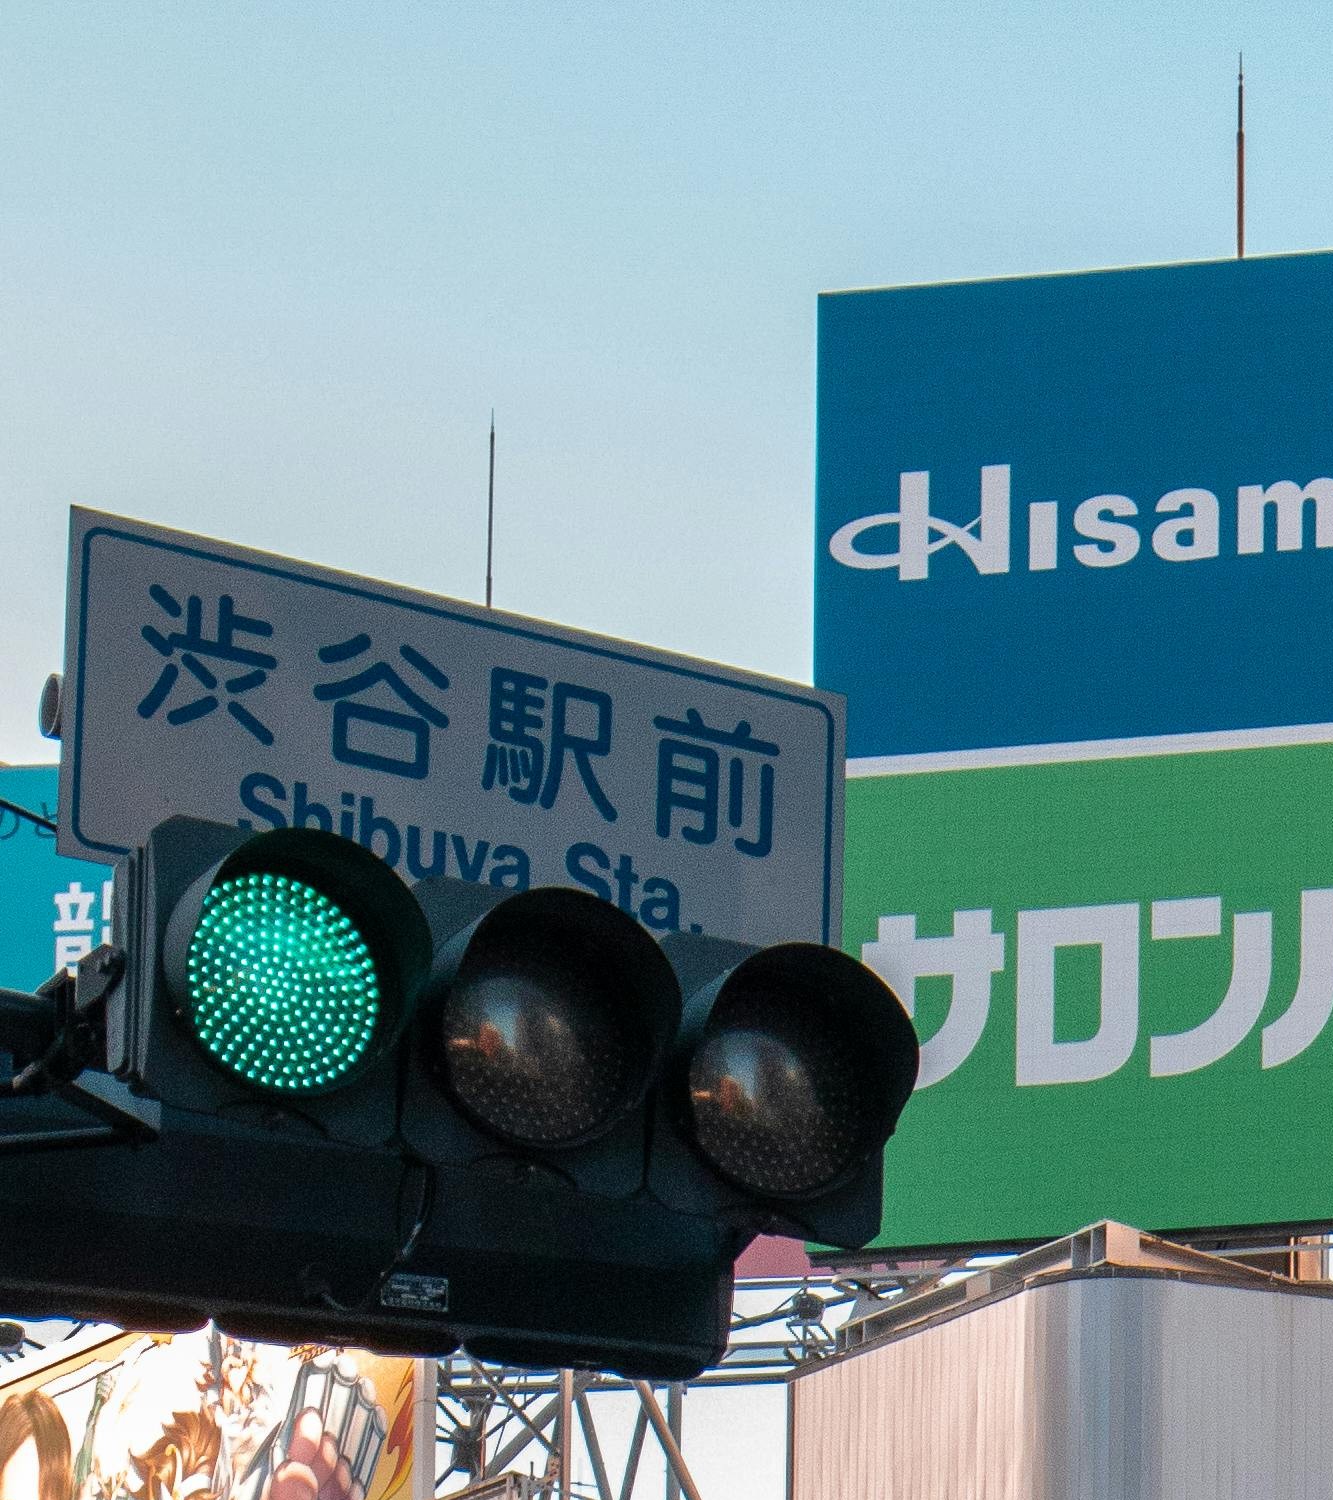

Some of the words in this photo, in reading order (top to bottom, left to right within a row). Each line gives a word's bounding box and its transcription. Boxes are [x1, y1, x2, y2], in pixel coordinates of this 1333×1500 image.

[137, 583, 781, 858] 渋谷駅前
[239, 772, 534, 888] Shibuya
[566, 842, 704, 933] Sta.
